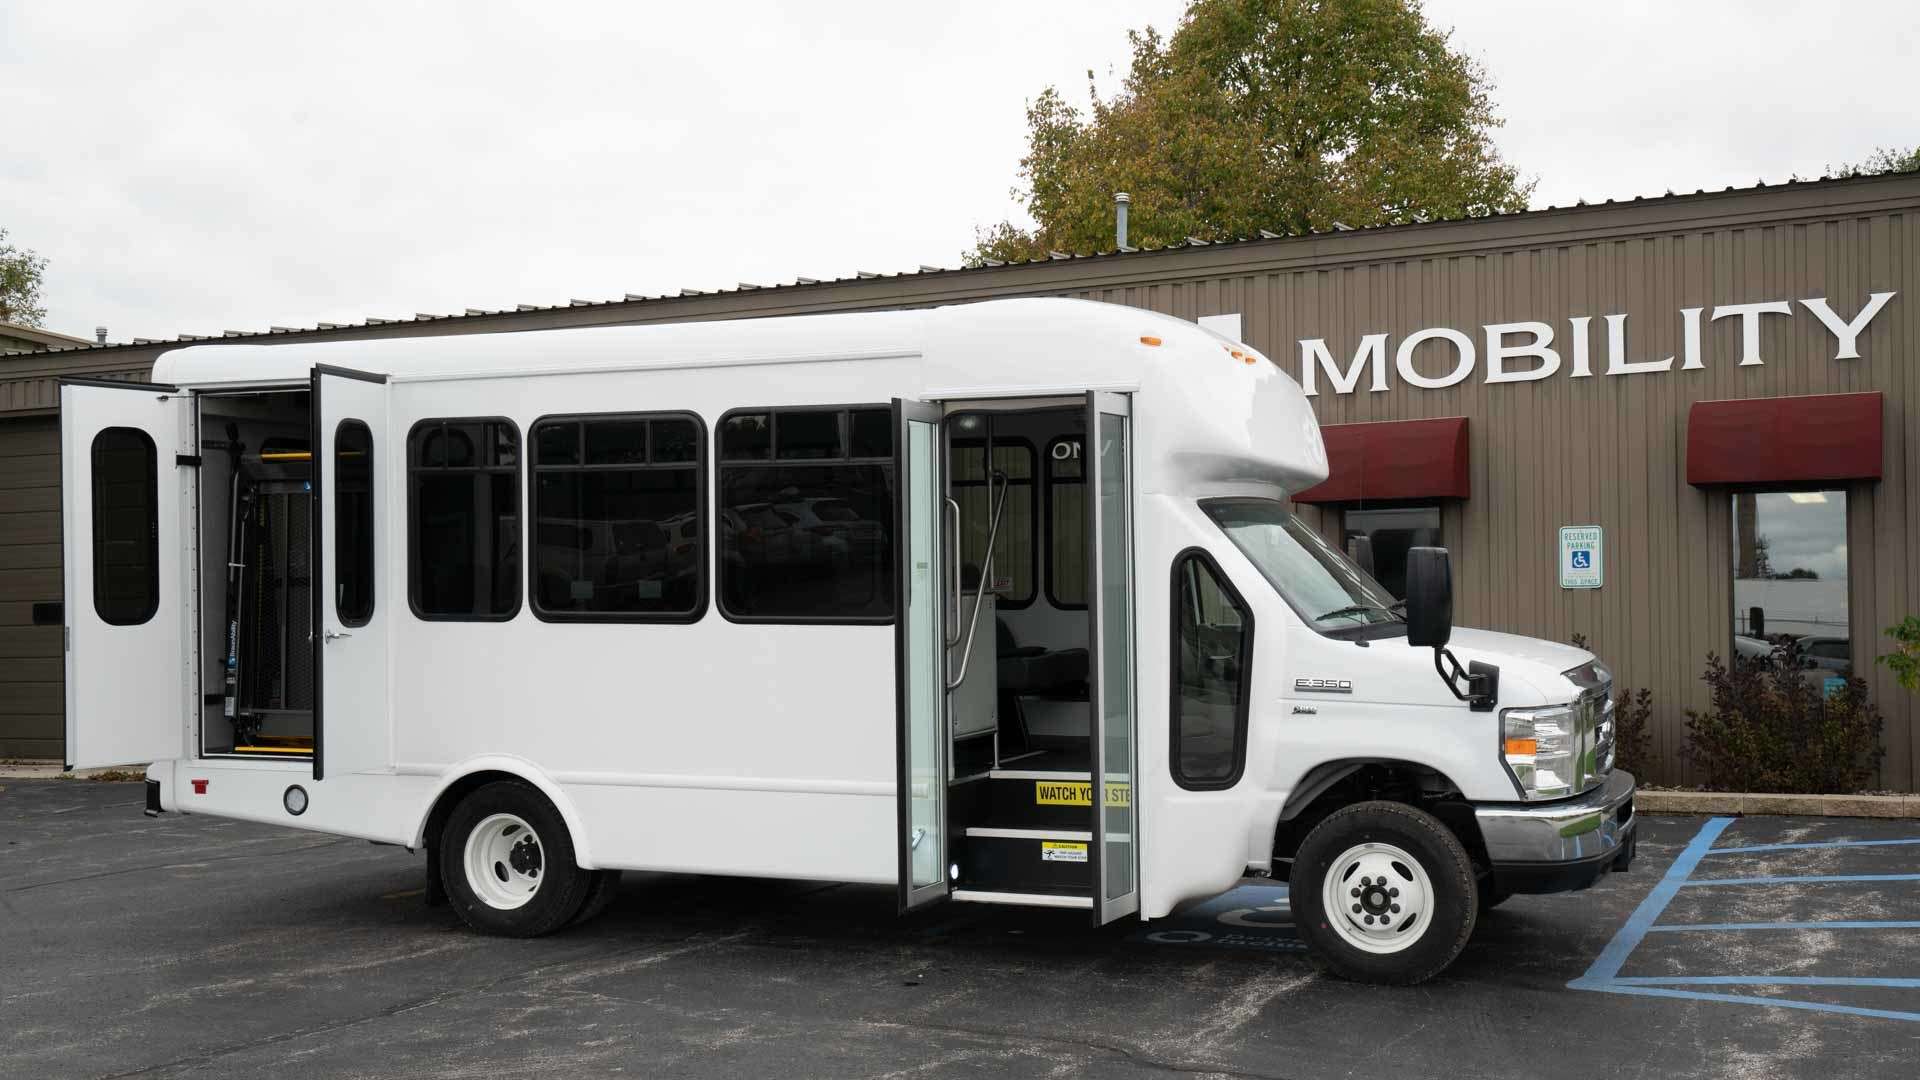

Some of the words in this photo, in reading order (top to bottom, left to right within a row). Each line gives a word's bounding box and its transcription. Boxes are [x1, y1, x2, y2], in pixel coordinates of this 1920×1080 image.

[1299, 291, 1897, 396] MOBILITY
[1564, 532, 1598, 541] RESERVED
[1567, 541, 1595, 550] PARKING
[1039, 786, 1077, 801] WATCH
